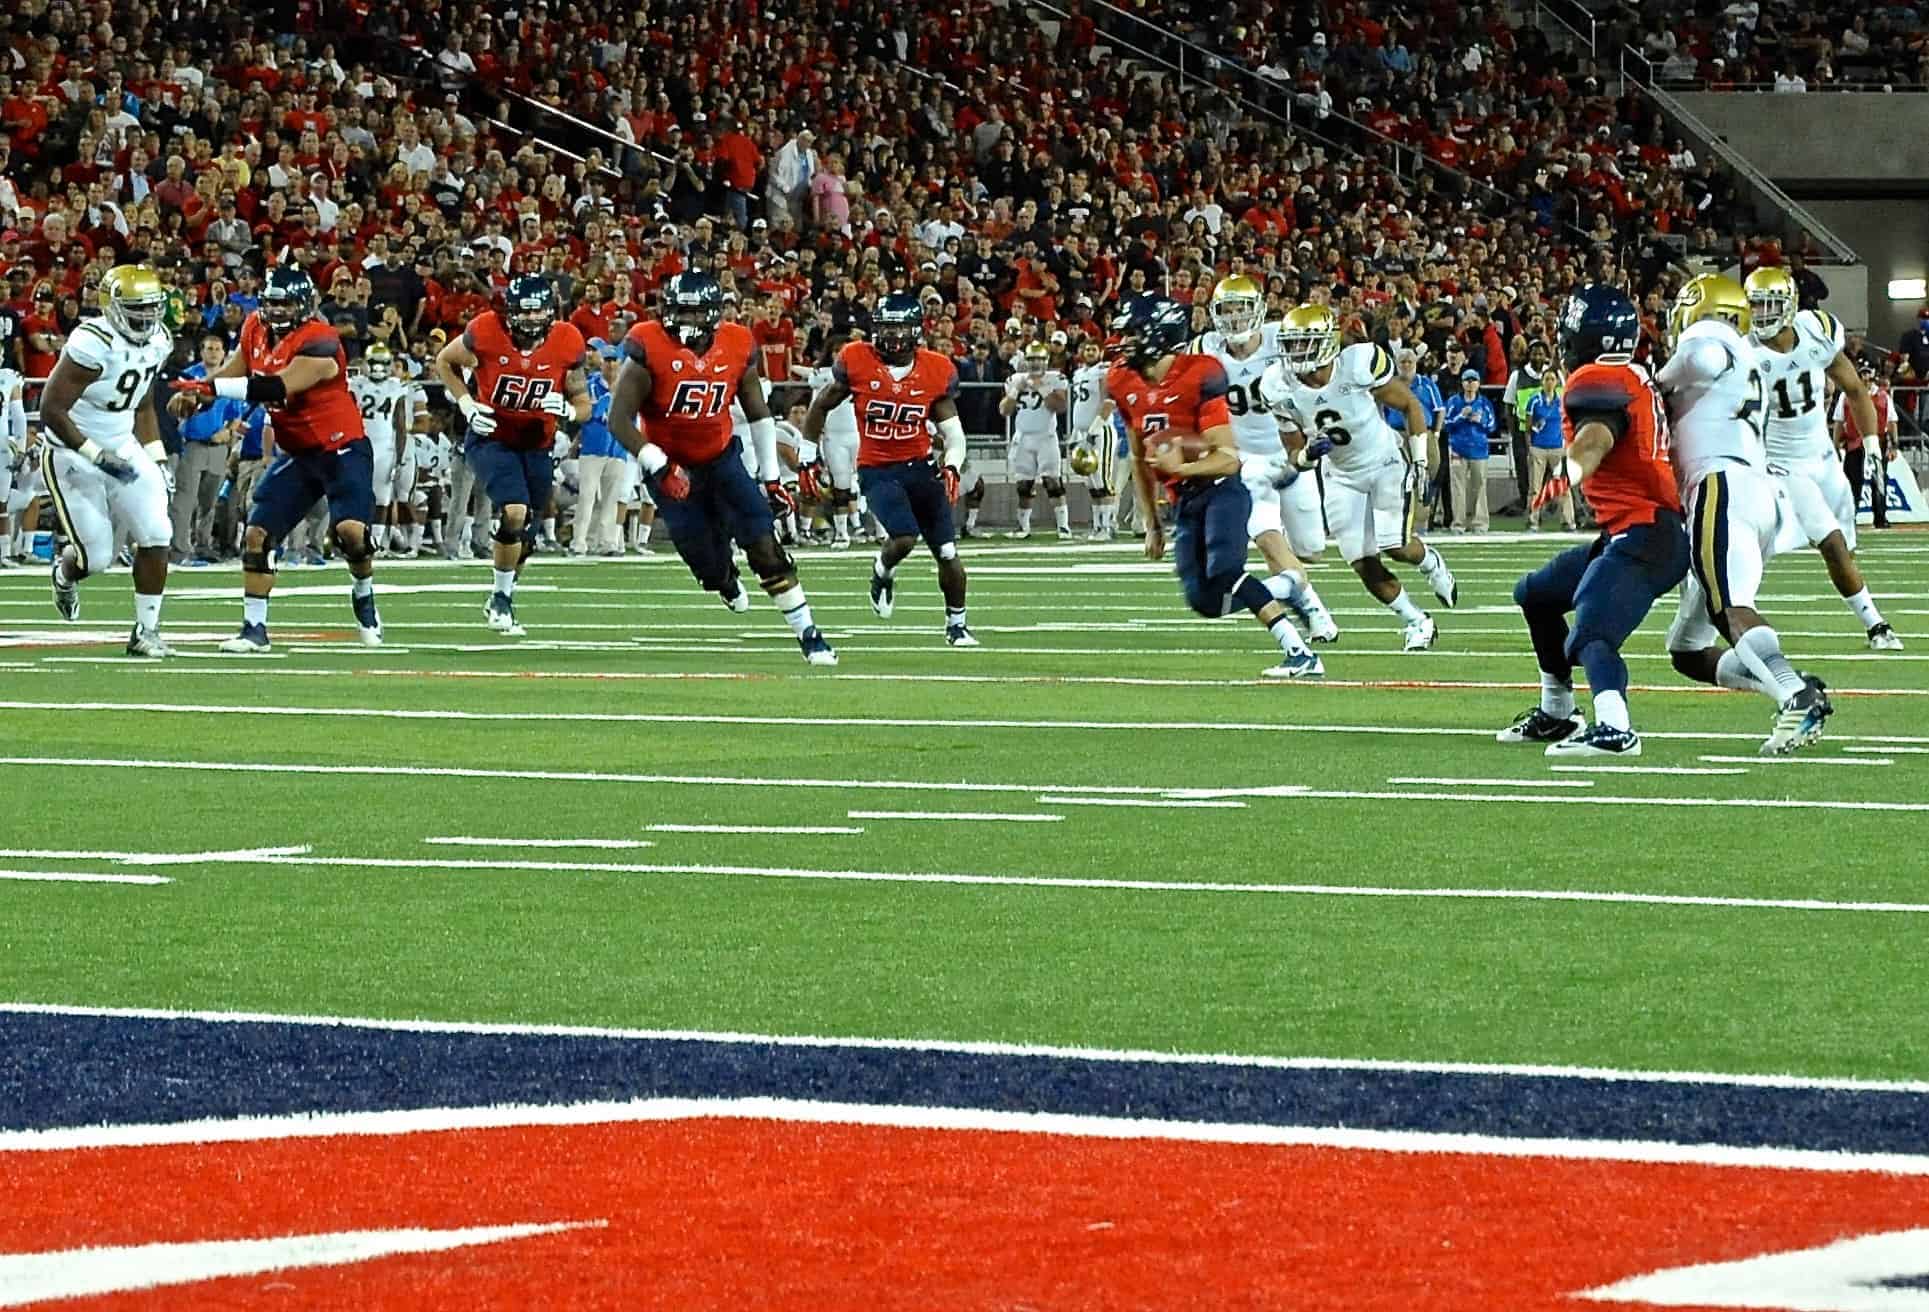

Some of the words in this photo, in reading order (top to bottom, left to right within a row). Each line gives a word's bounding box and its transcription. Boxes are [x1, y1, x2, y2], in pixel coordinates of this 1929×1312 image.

[360, 394, 393, 420] 24
[490, 374, 554, 412] 68
[665, 380, 728, 419] 61
[1771, 370, 1817, 418] 11
[865, 399, 926, 440] 25
[1314, 408, 1352, 446] 6
